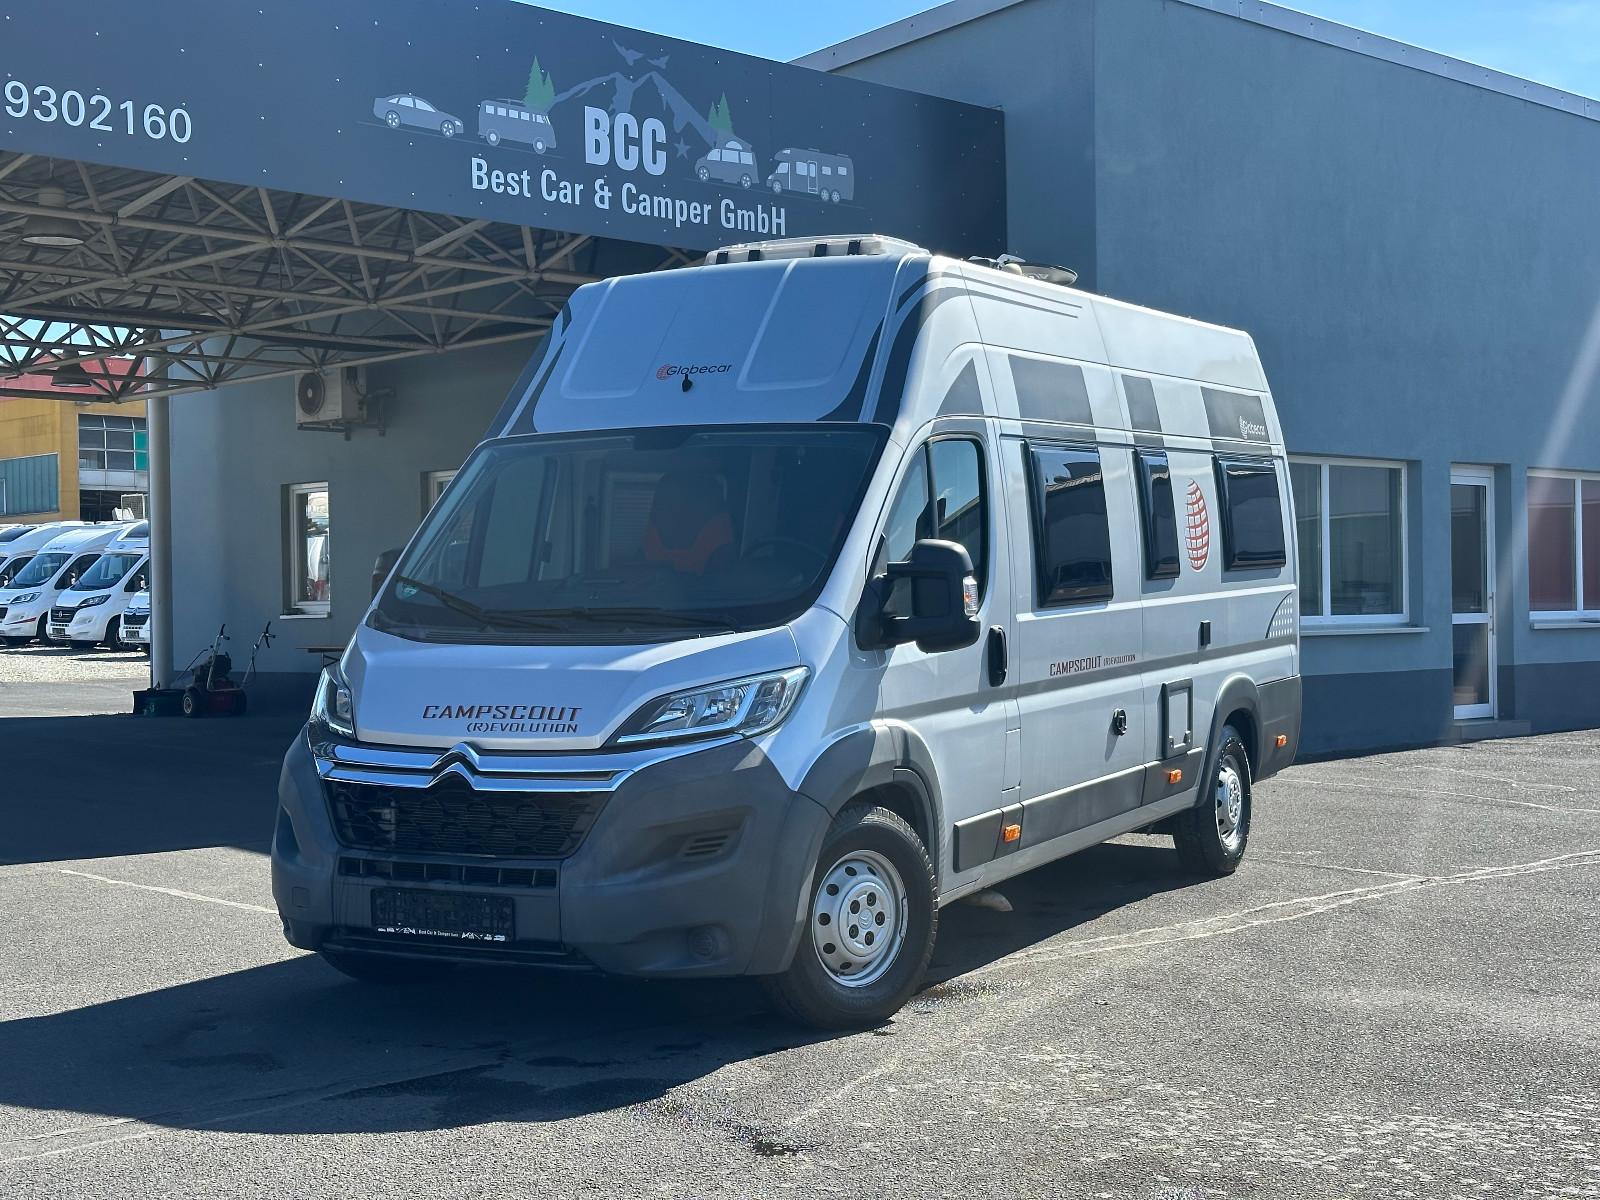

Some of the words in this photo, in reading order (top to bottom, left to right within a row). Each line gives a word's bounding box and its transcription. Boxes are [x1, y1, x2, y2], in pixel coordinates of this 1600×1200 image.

[4, 80, 192, 143] 9302160
[584, 105, 667, 176] BCC
[471, 157, 531, 198] Best
[540, 169, 583, 205] Car
[594, 178, 612, 210] &
[621, 182, 712, 228] Camper
[720, 199, 786, 236] GmbH
[666, 364, 732, 376] Globecar
[1049, 655, 1102, 677] CAMPSCOUT
[422, 705, 583, 722] CAMPSCOUT
[466, 722, 578, 734] (R)EVOLUTION
